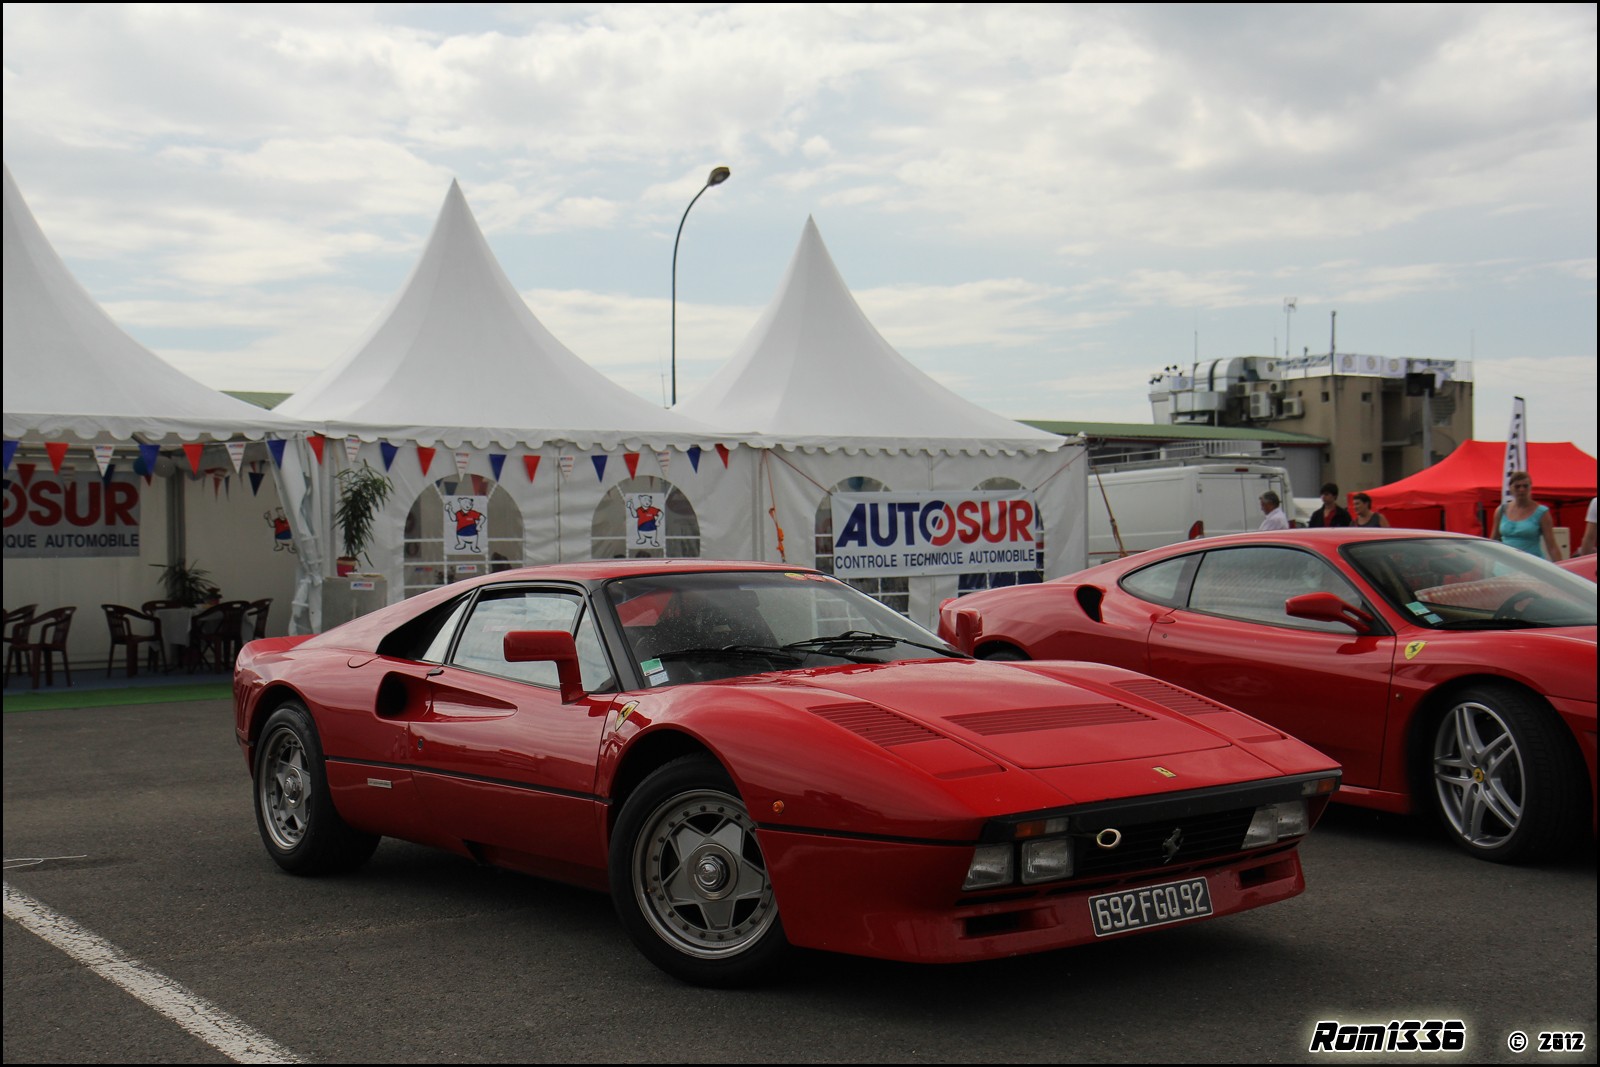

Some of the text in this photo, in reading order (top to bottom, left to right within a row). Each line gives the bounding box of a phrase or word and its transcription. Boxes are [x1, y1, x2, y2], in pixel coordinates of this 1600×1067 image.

[835, 500, 1034, 548] AUTOSUR
[3, 533, 140, 549] QUE AUTOMOBILE
[835, 549, 1035, 569] CONTROLE TECHNIQUE AUTOMOBILE
